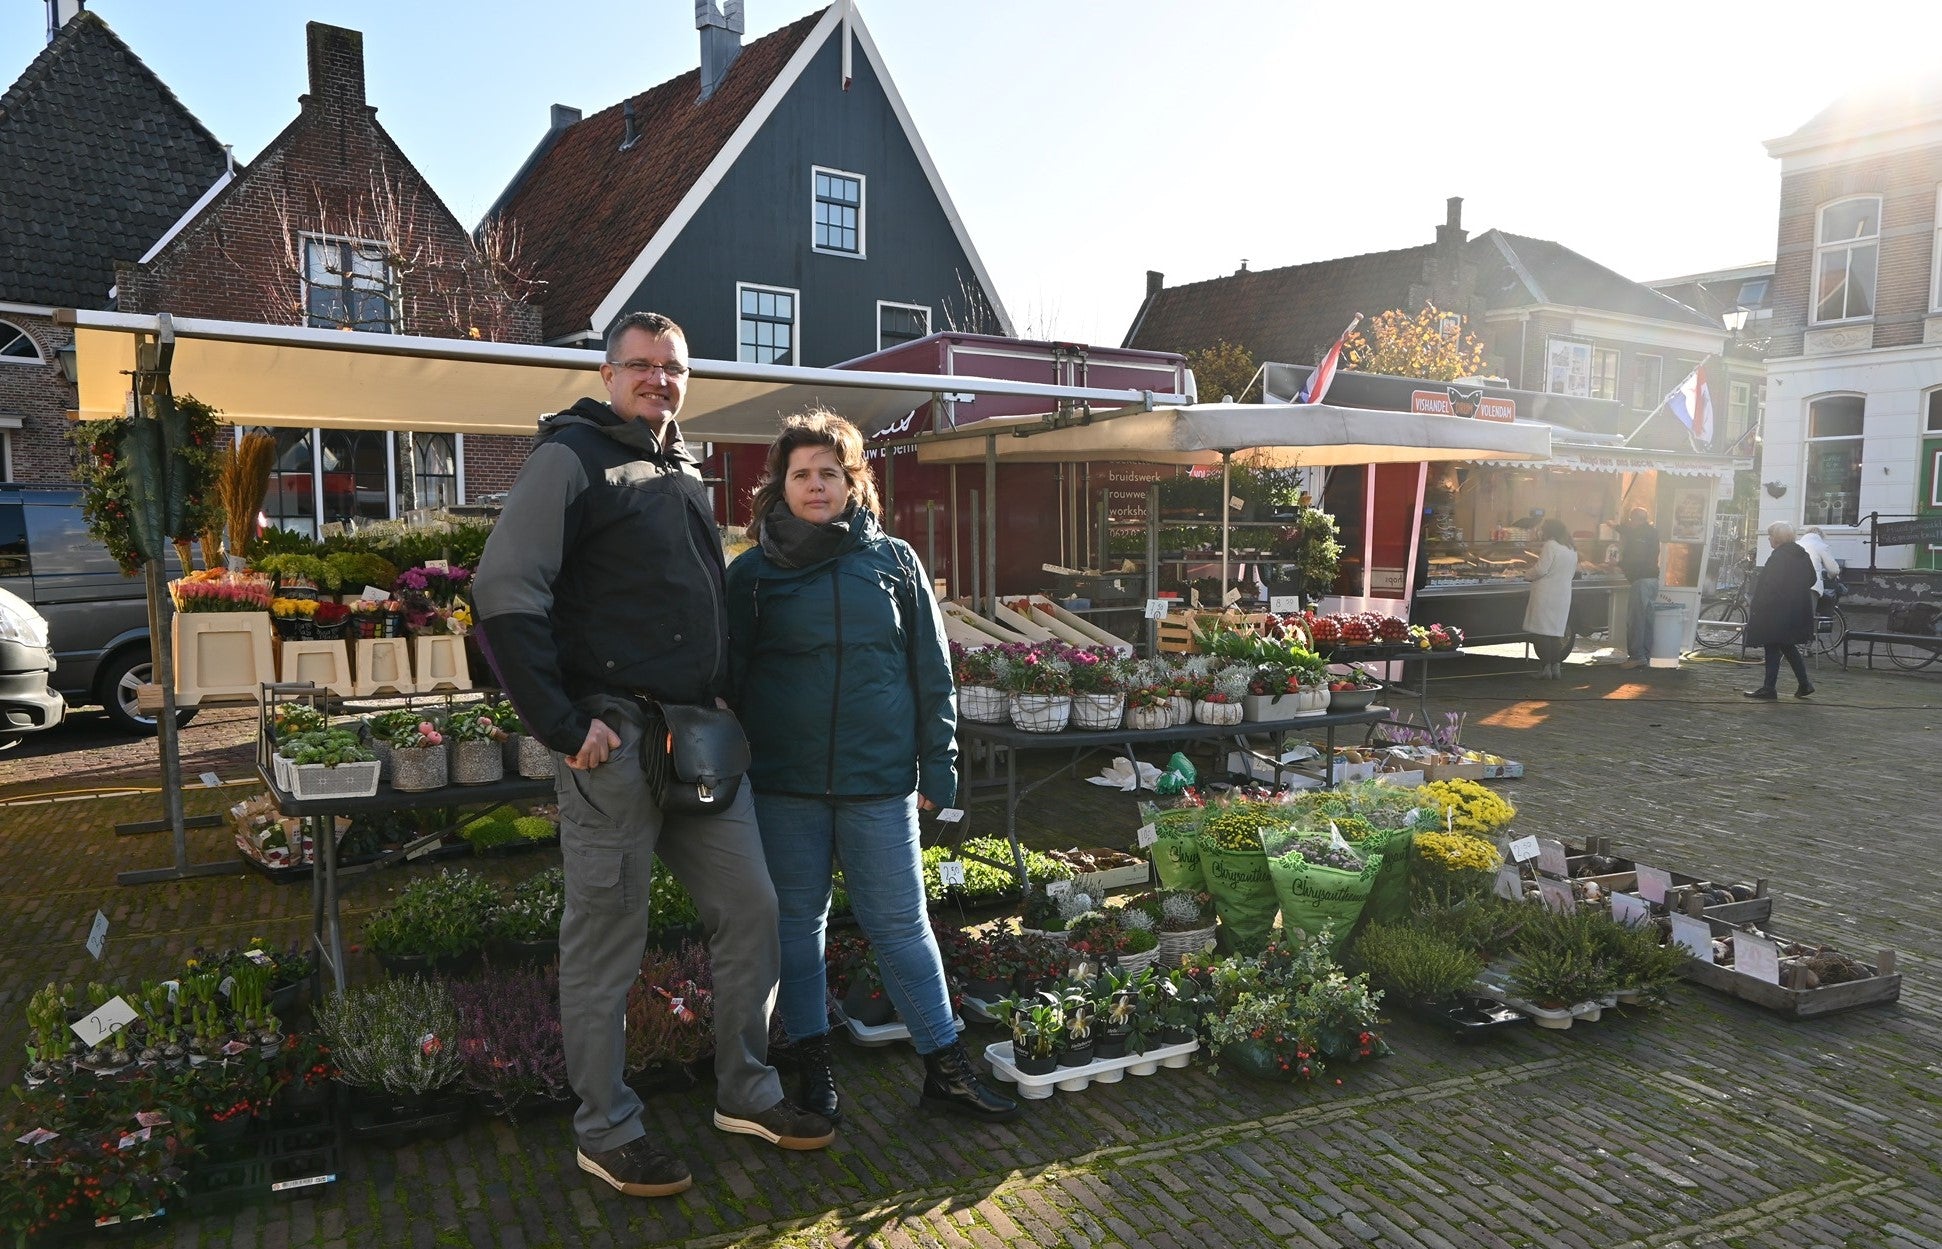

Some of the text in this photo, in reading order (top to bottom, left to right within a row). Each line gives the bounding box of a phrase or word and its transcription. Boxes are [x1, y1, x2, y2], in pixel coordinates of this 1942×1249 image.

[1415, 398, 1450, 414] VISHANDEL
[1481, 404, 1512, 419] VOLENDAM
[1109, 471, 1160, 481] bruidswerk
[1109, 491, 1147, 499] rouwwe
[1109, 505, 1147, 516] worksho
